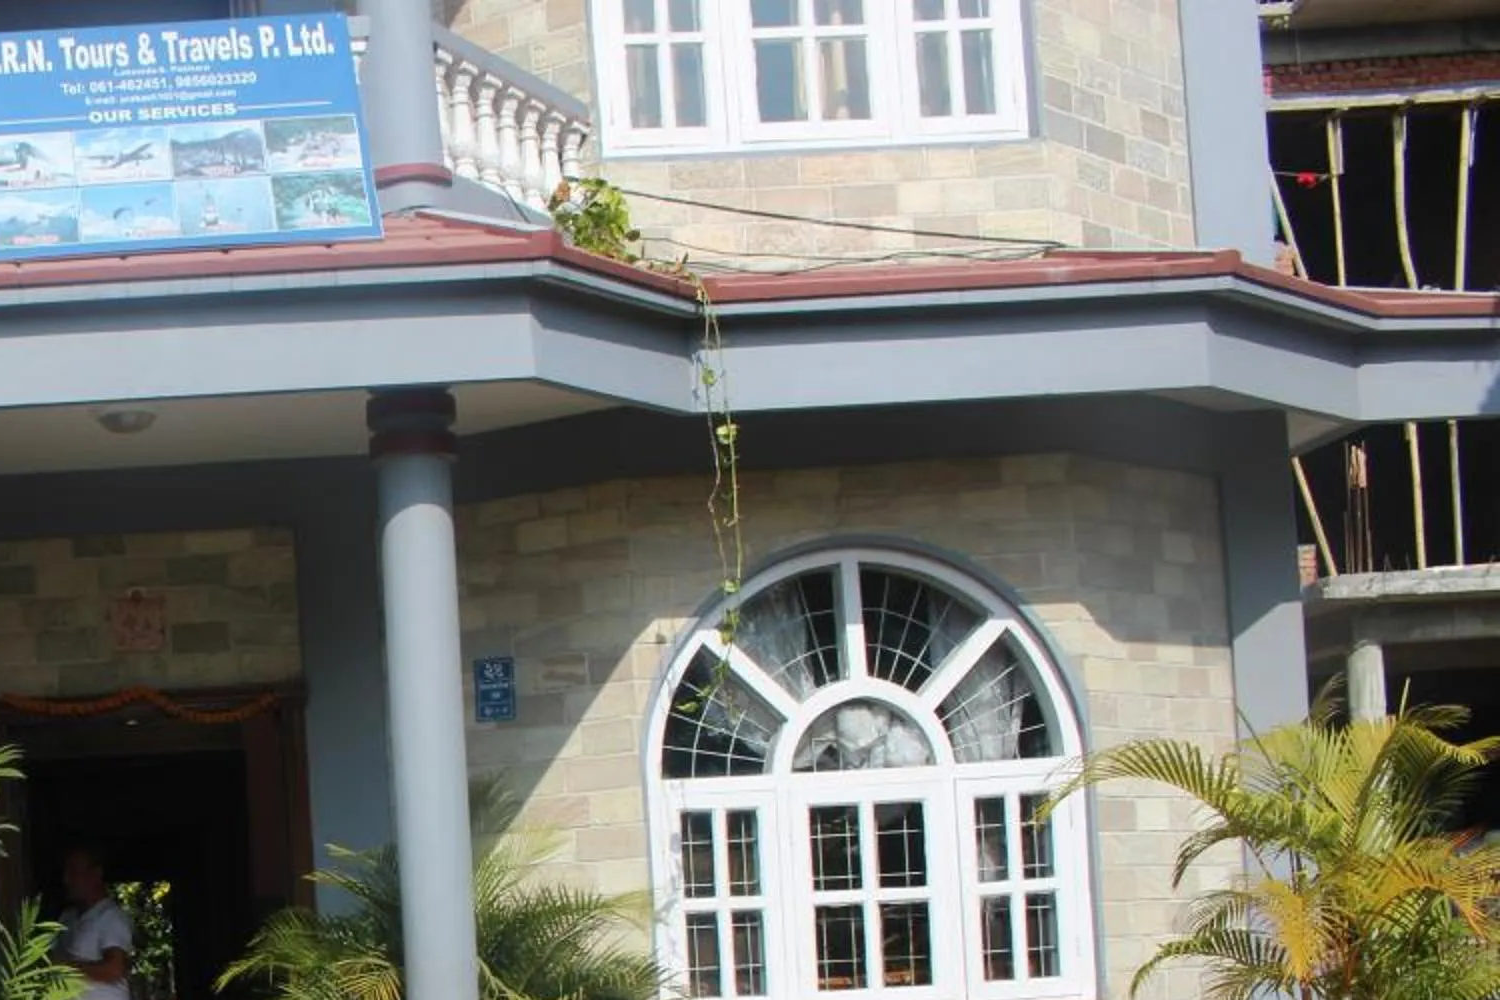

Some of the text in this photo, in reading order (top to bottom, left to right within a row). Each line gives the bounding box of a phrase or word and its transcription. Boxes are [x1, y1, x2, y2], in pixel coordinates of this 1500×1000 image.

[57, 35, 130, 71] Tours
[137, 32, 157, 65] &
[160, 26, 254, 64] Travels
[258, 24, 281, 59] P.
[285, 21, 335, 57] Ltd.
[87, 102, 238, 125] OUR SERVICES
